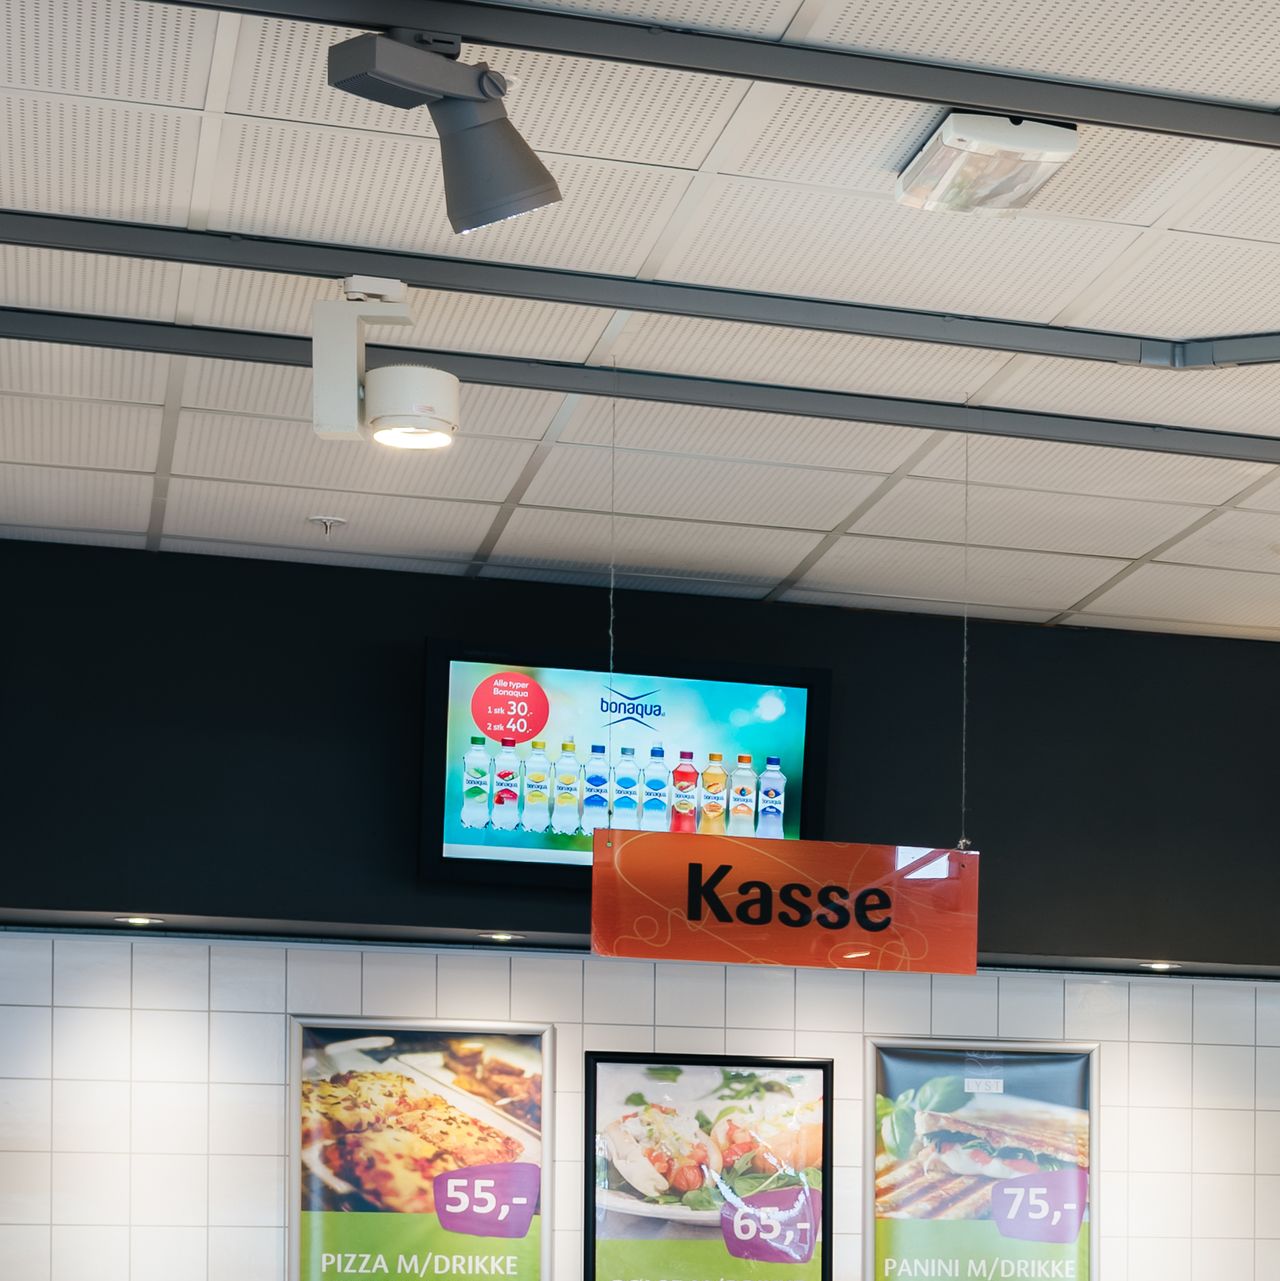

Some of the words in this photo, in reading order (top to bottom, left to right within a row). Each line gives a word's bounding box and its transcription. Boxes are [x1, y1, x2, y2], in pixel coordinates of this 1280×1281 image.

[493, 679, 509, 687] Alle
[509, 680, 529, 690] typer
[493, 687, 529, 698] Bonaqua
[487, 706, 492, 714] 1
[493, 706, 505, 715] stk
[507, 701, 533, 717] 30,-
[600, 697, 662, 719] bonaqua
[487, 722, 492, 731] 2
[493, 723, 504, 732] stk
[506, 718, 532, 734] 40,-
[686, 862, 893, 933] Kasse
[965, 1080, 1003, 1092] LYST
[445, 1178, 528, 1222] 55,-
[1003, 1187, 1077, 1226] 75,-
[732, 1207, 811, 1246] 65,-
[320, 1253, 389, 1274] PIZZA
[396, 1252, 519, 1278] M/DRIKKE
[884, 1258, 960, 1278] PANINI
[967, 1257, 1076, 1281] M/DRIKKE
